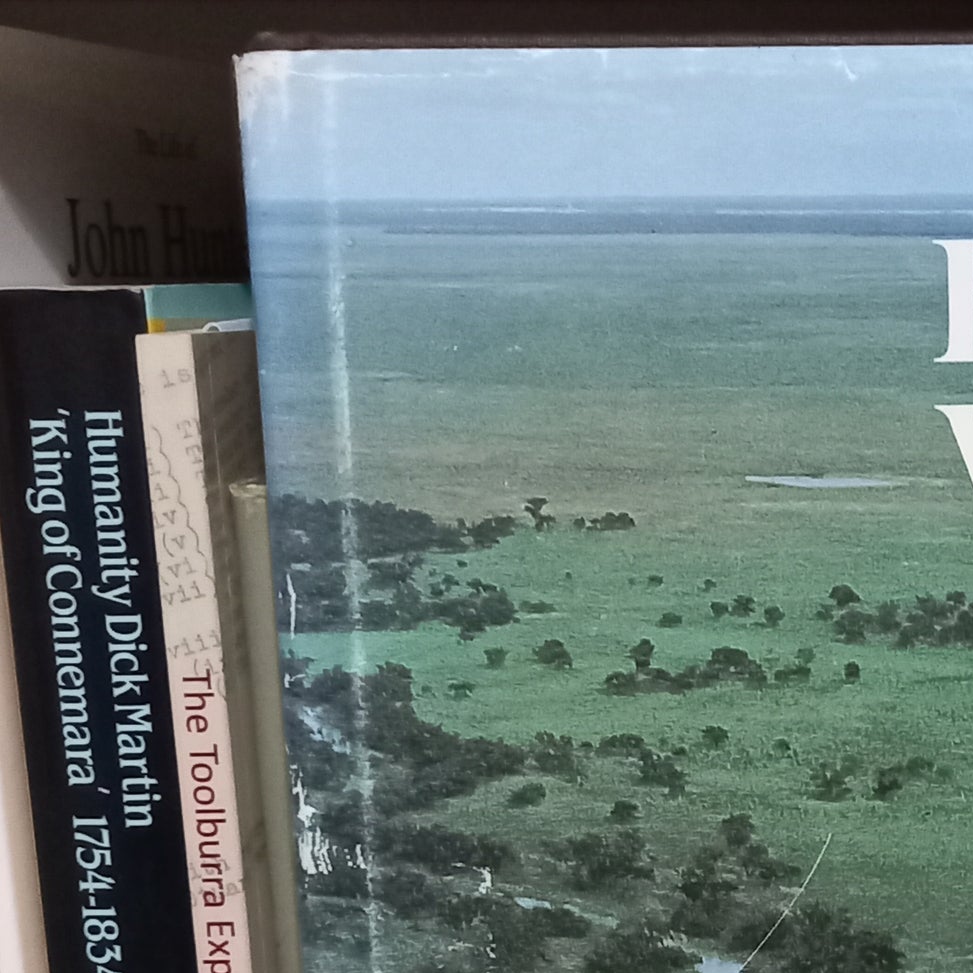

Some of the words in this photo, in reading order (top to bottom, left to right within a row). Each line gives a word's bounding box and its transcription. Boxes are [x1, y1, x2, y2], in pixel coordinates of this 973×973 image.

[65, 197, 151, 279] John
[41, 520, 81, 561] of
[84, 410, 140, 607] Humanity
[105, 614, 150, 698] Dick
[182, 668, 215, 734] The
[114, 703, 161, 828] Martin
[189, 744, 227, 908] Toolburra
